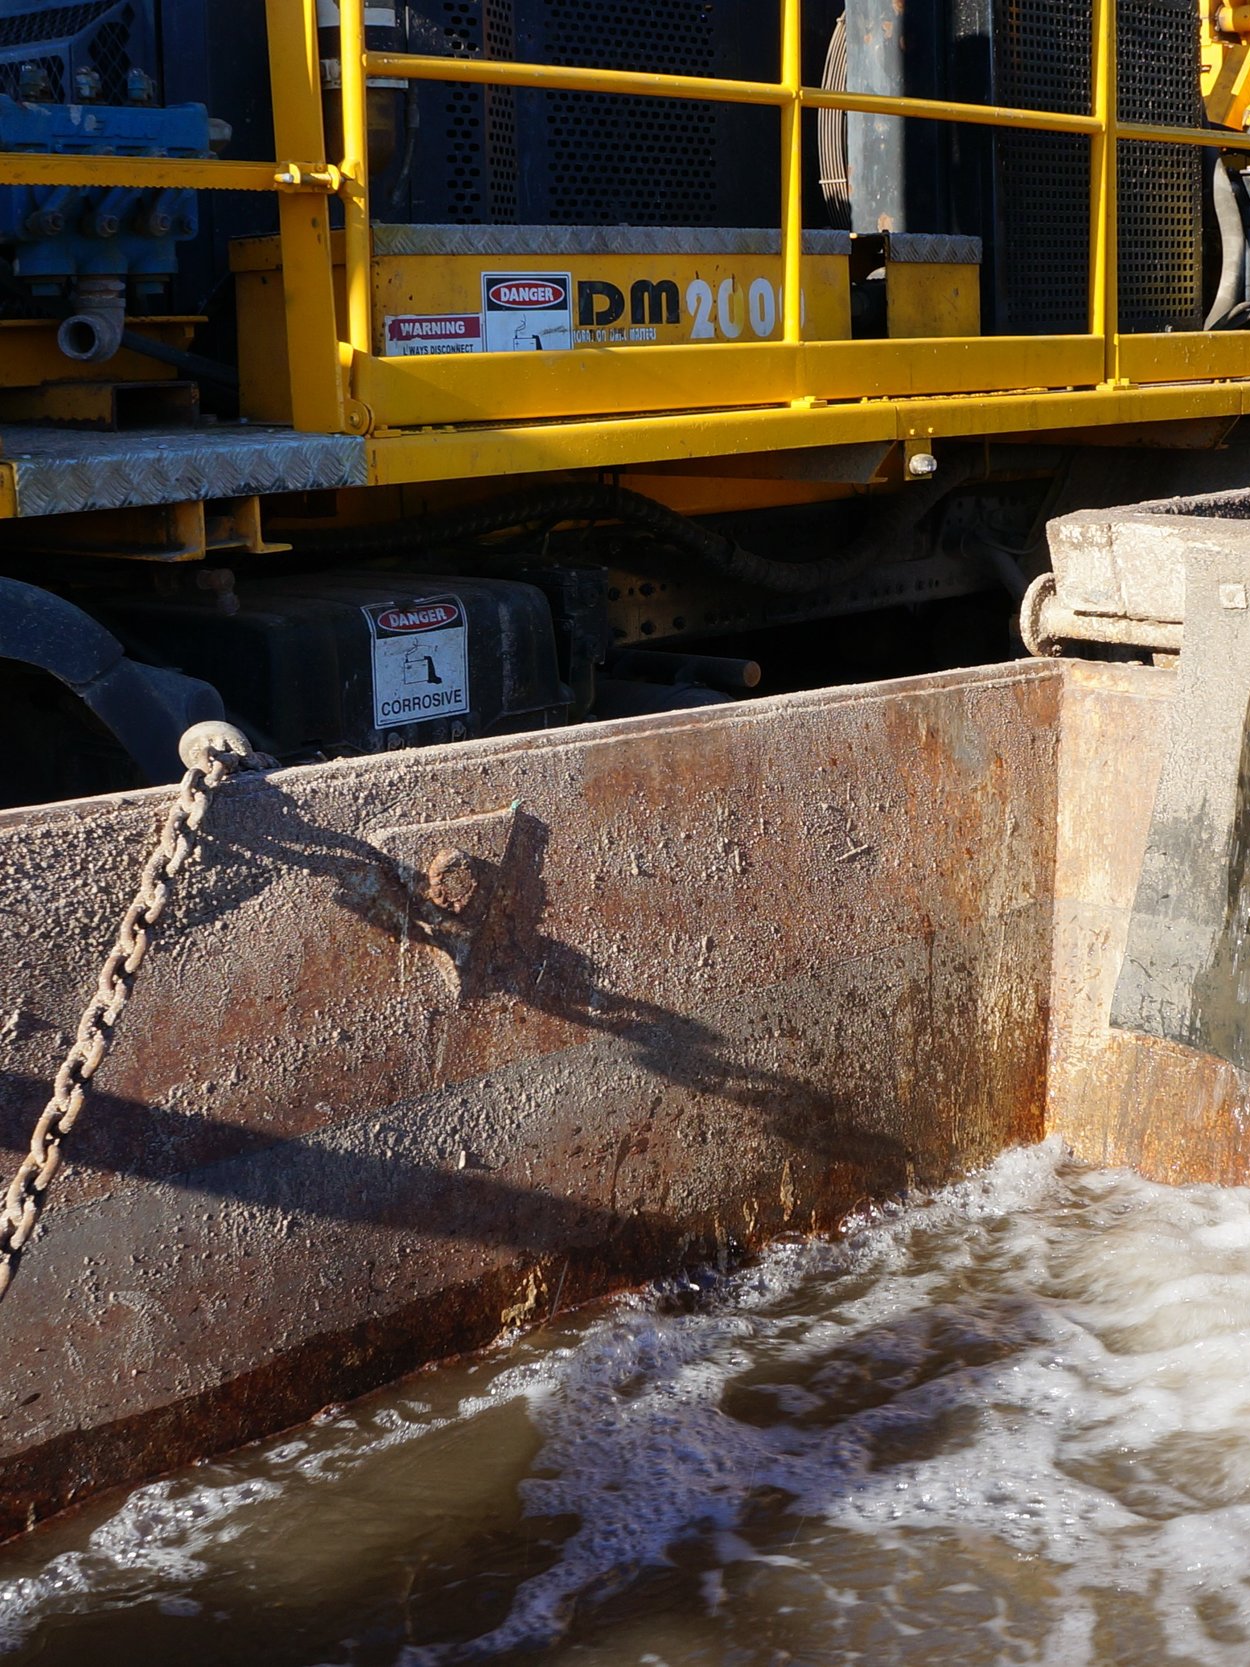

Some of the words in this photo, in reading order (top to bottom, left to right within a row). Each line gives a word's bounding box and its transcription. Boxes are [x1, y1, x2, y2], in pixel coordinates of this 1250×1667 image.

[500, 287, 554, 302] DANGER
[400, 321, 465, 336] WARNING
[431, 344, 474, 354] DISCONNECT
[389, 607, 448, 628] DANGER
[381, 689, 462, 716] CORROSIVE
